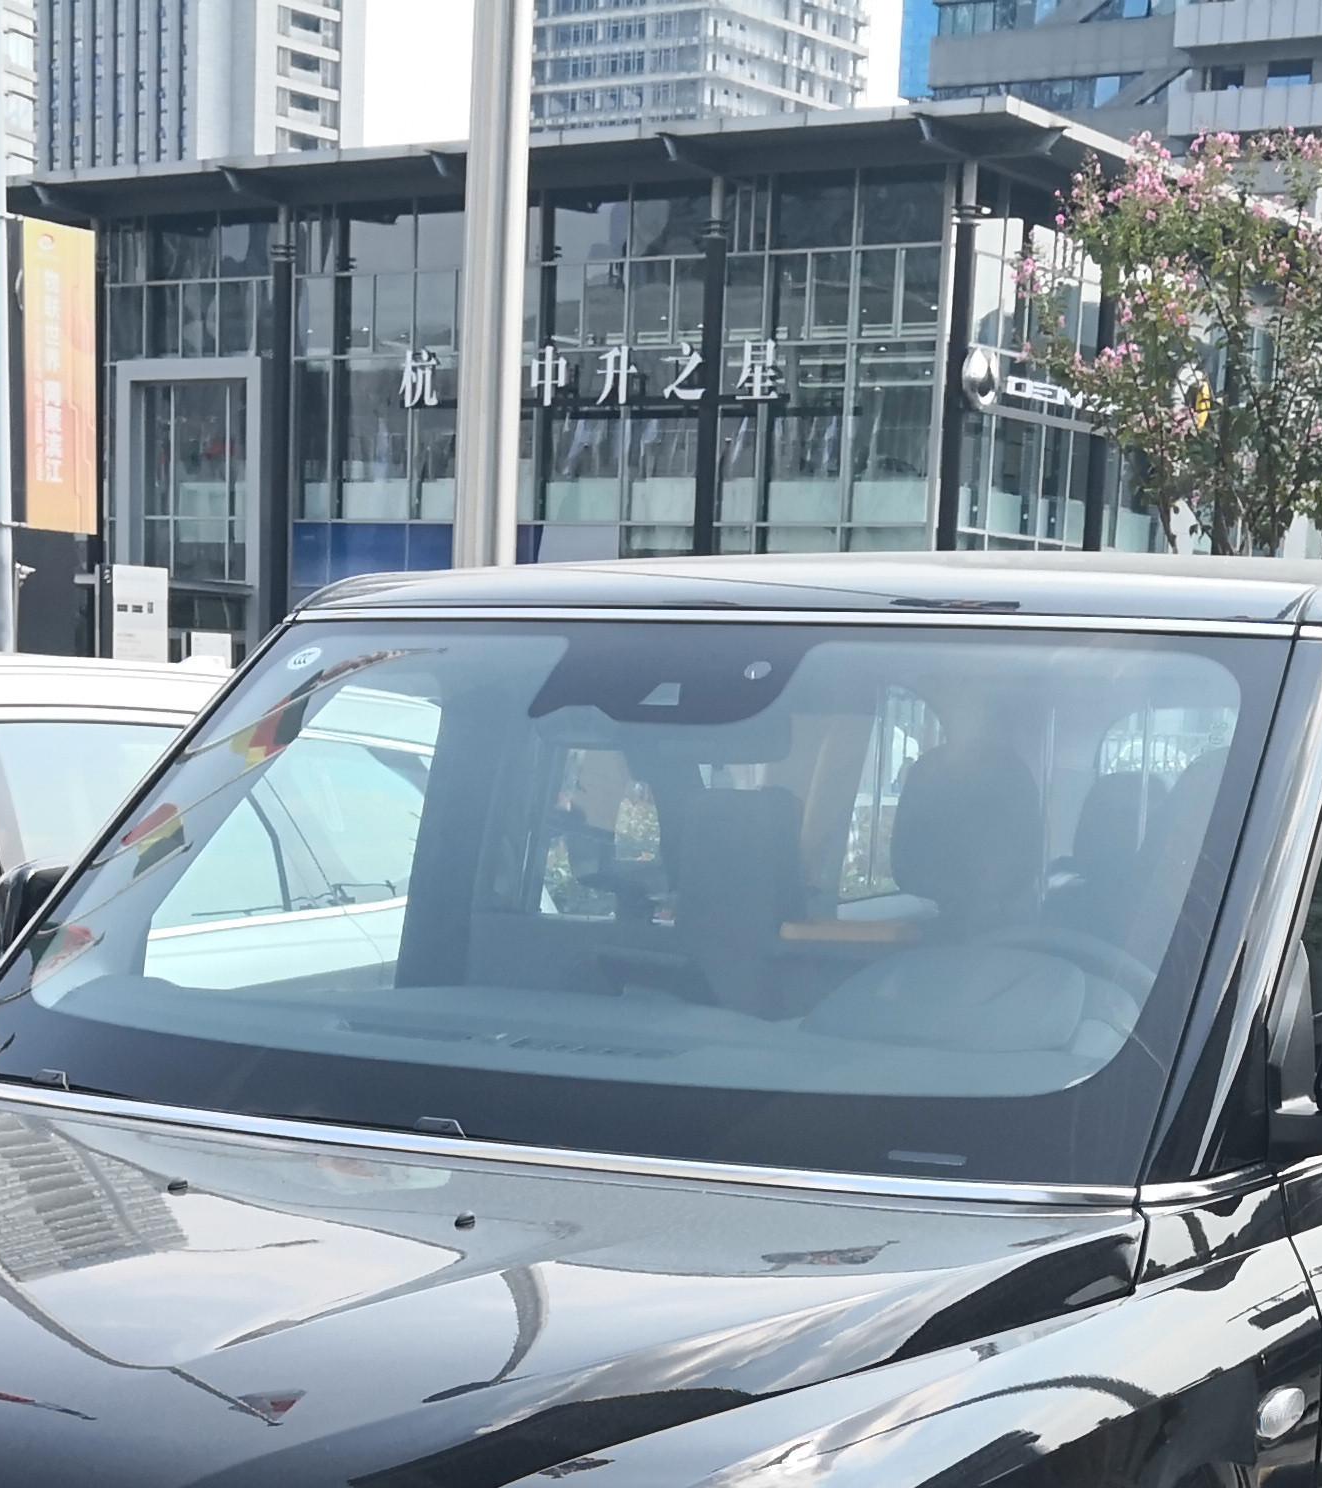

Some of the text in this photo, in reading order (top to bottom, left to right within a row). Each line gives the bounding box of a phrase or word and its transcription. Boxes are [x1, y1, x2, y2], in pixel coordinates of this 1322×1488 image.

[398, 339, 780, 408] 杭中升之星
[1006, 376, 1119, 416] DENZ
